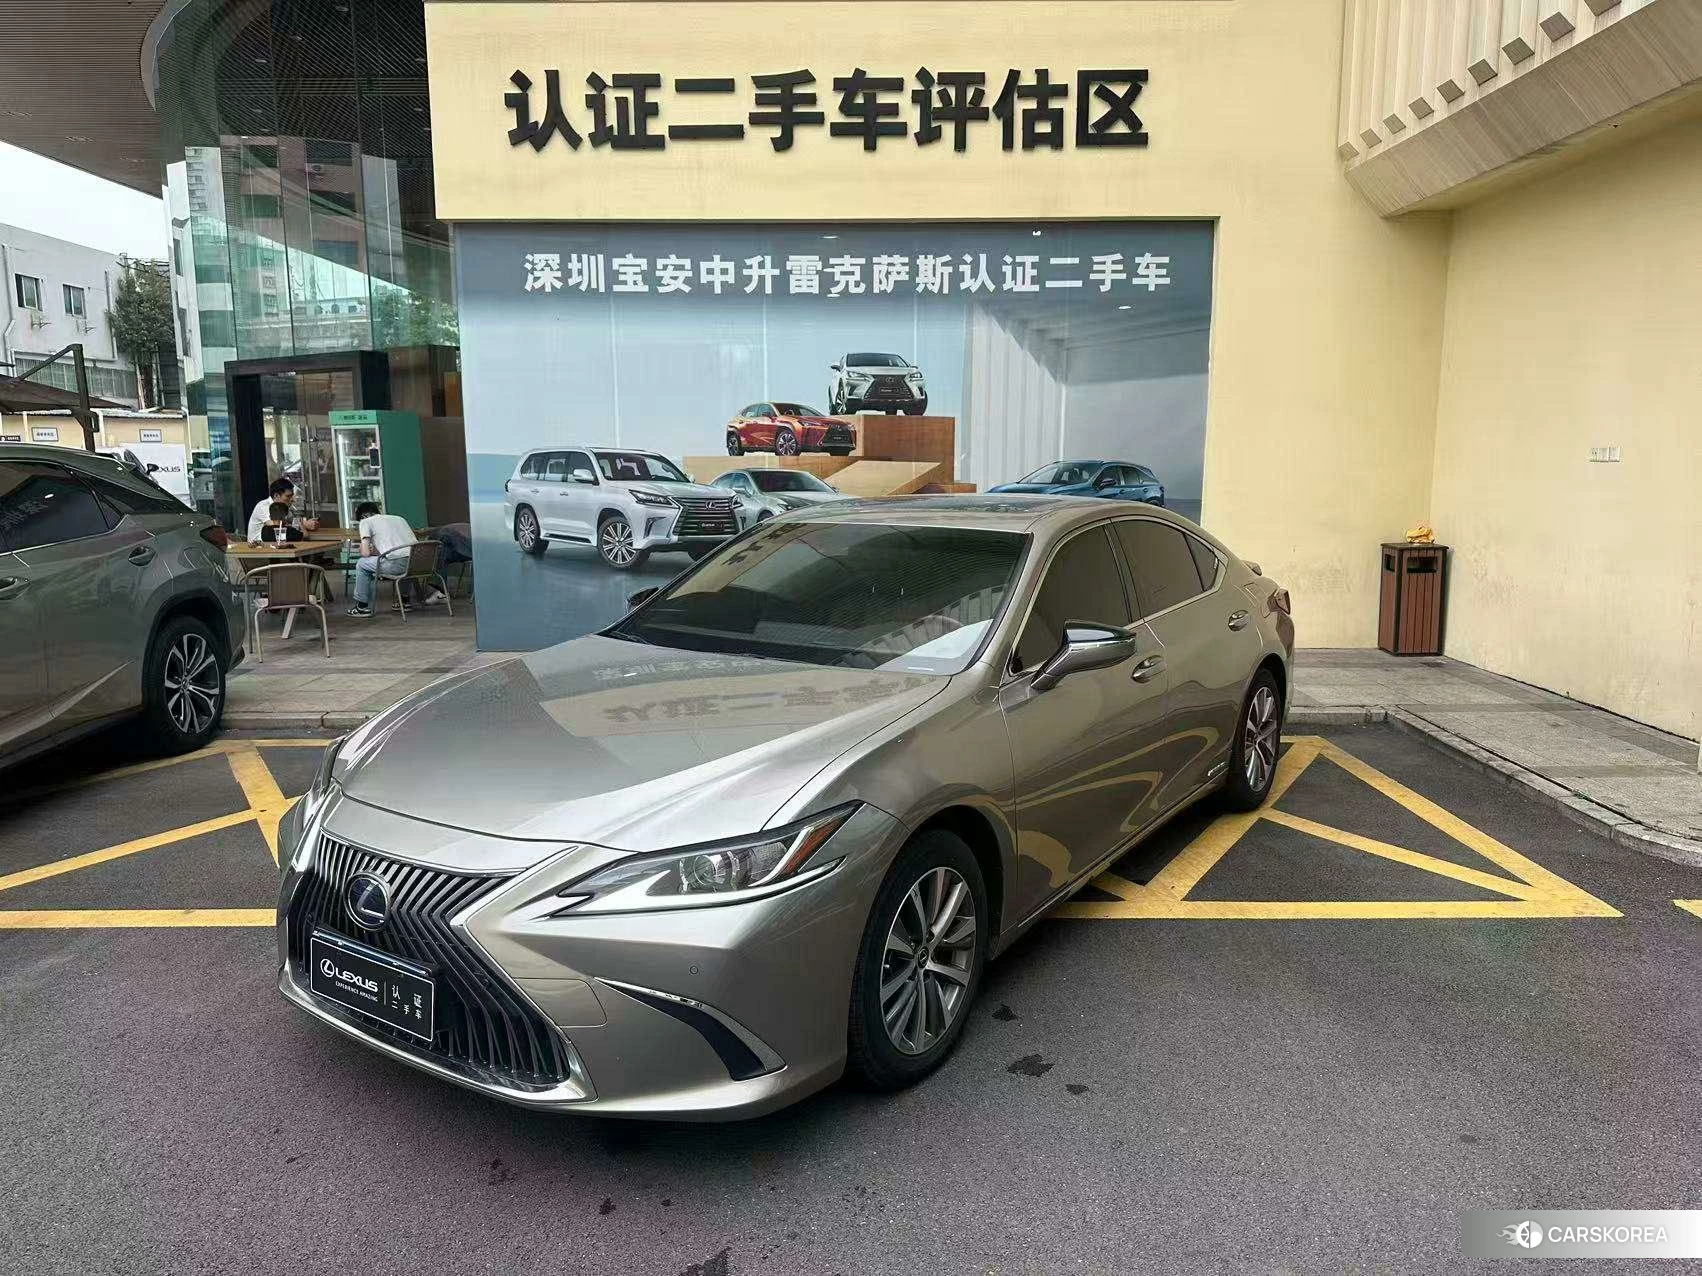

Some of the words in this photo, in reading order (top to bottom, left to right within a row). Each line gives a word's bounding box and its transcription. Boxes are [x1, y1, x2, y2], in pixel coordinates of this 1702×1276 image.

[504, 67, 1149, 152] 认证二手车评估区
[523, 252, 1172, 295] 深圳宝安中升雷克萨斯认证二手车
[335, 967, 378, 993] LEXUS
